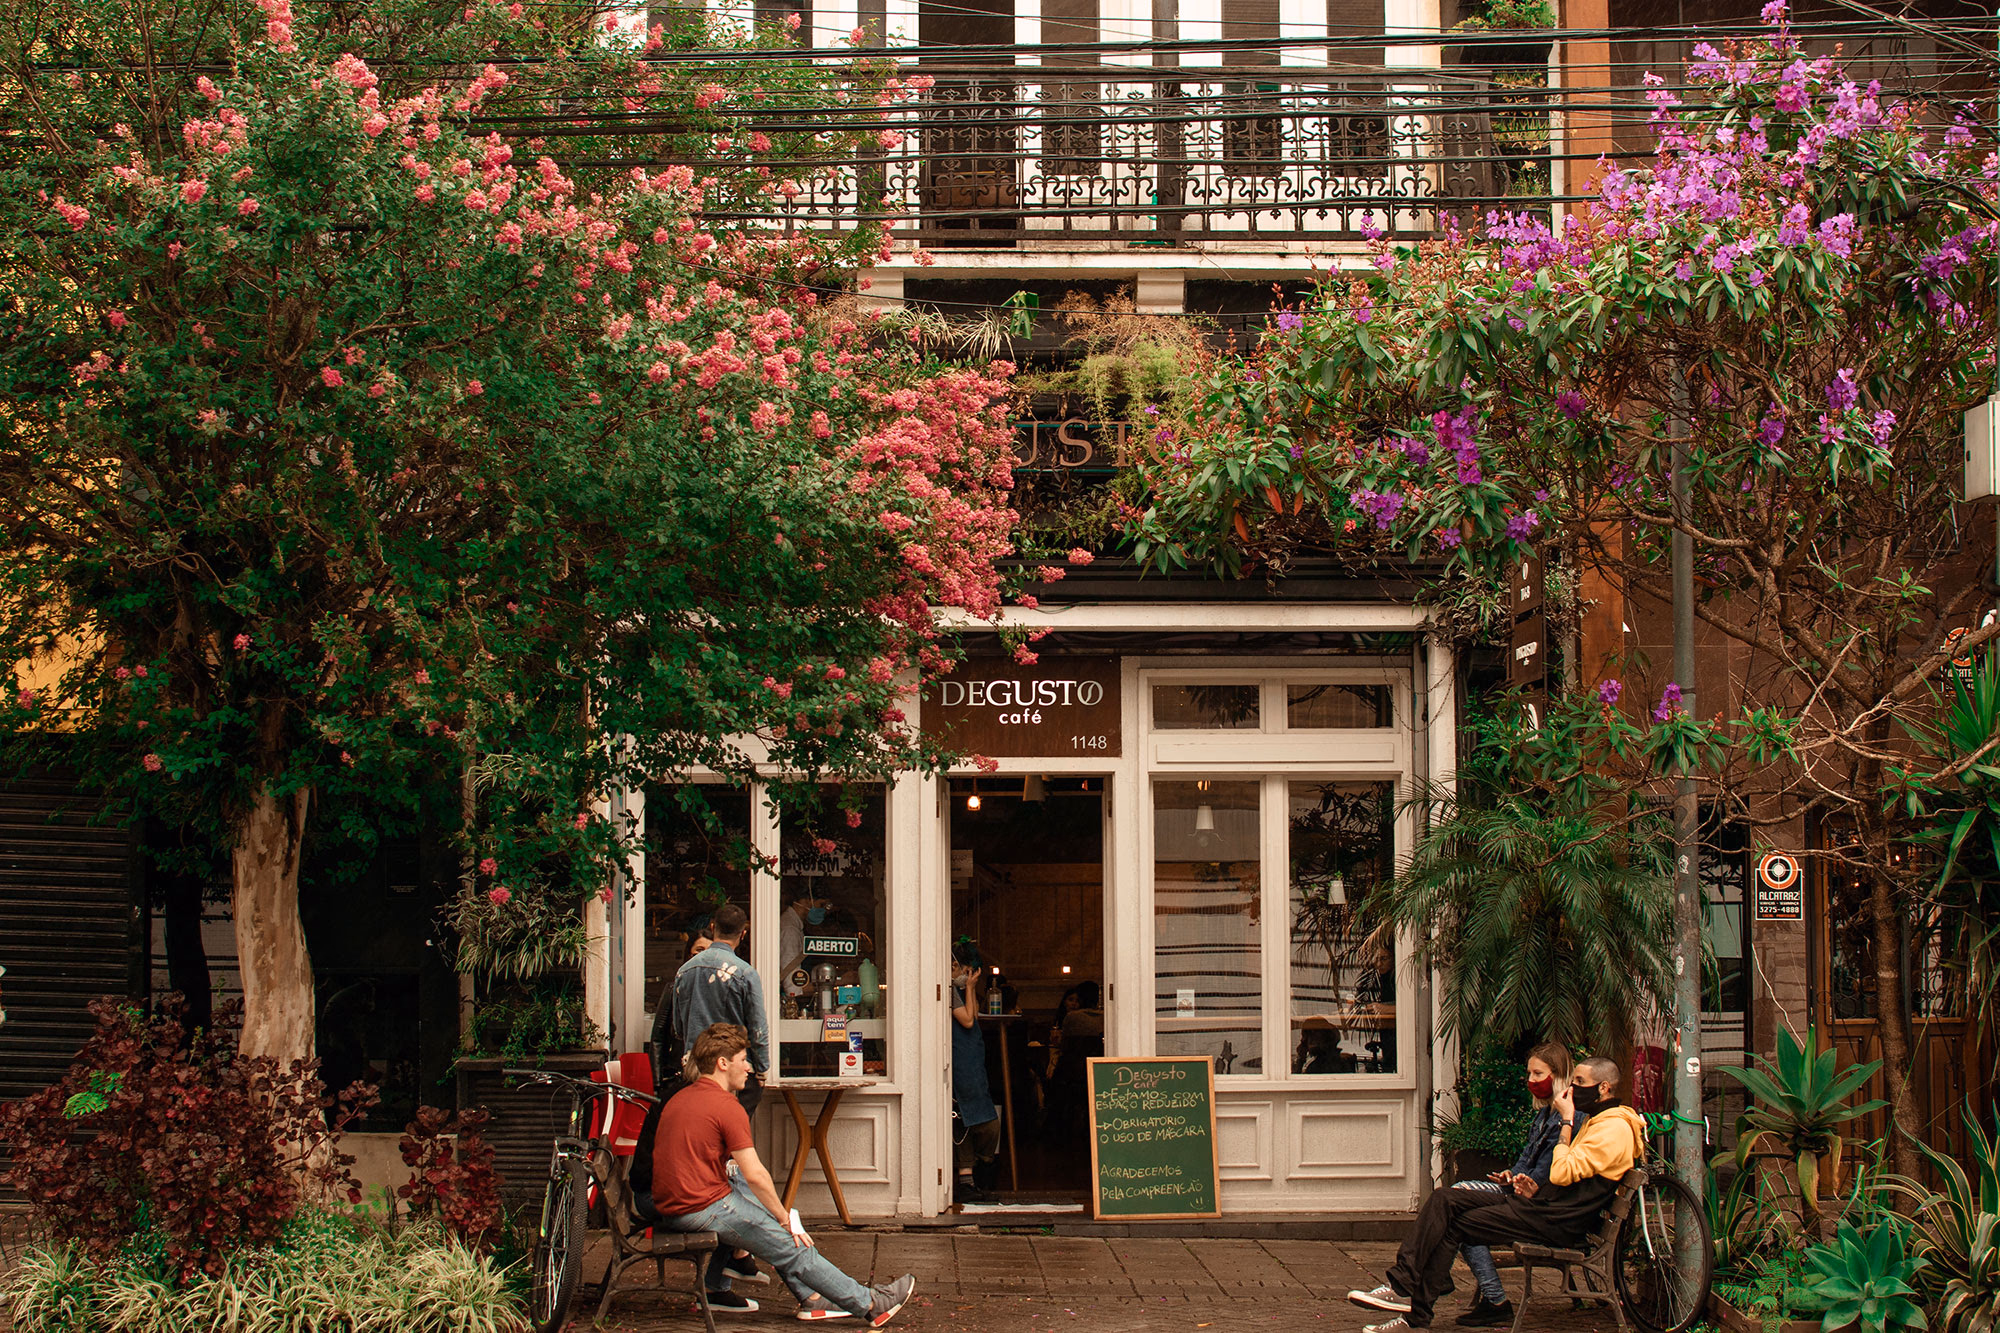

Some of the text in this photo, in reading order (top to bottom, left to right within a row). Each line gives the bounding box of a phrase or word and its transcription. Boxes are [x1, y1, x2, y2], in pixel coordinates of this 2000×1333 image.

[940, 680, 1104, 706] DEGUSTO
[998, 708, 1043, 725] café
[1071, 735, 1107, 750] 1148
[1759, 891, 1800, 900] ALCATRAZ
[807, 940, 854, 953] ABERTO
[1173, 1092, 1204, 1102] COM
[1096, 1100, 1197, 1113] ESPAÇO REDUZIDO
[1112, 1115, 1186, 1131] OBRIGATÓRIO
[1100, 1125, 1206, 1144] O USO DE MÁSCARA
[1100, 1164, 1183, 1179] AGRADECEMOS
